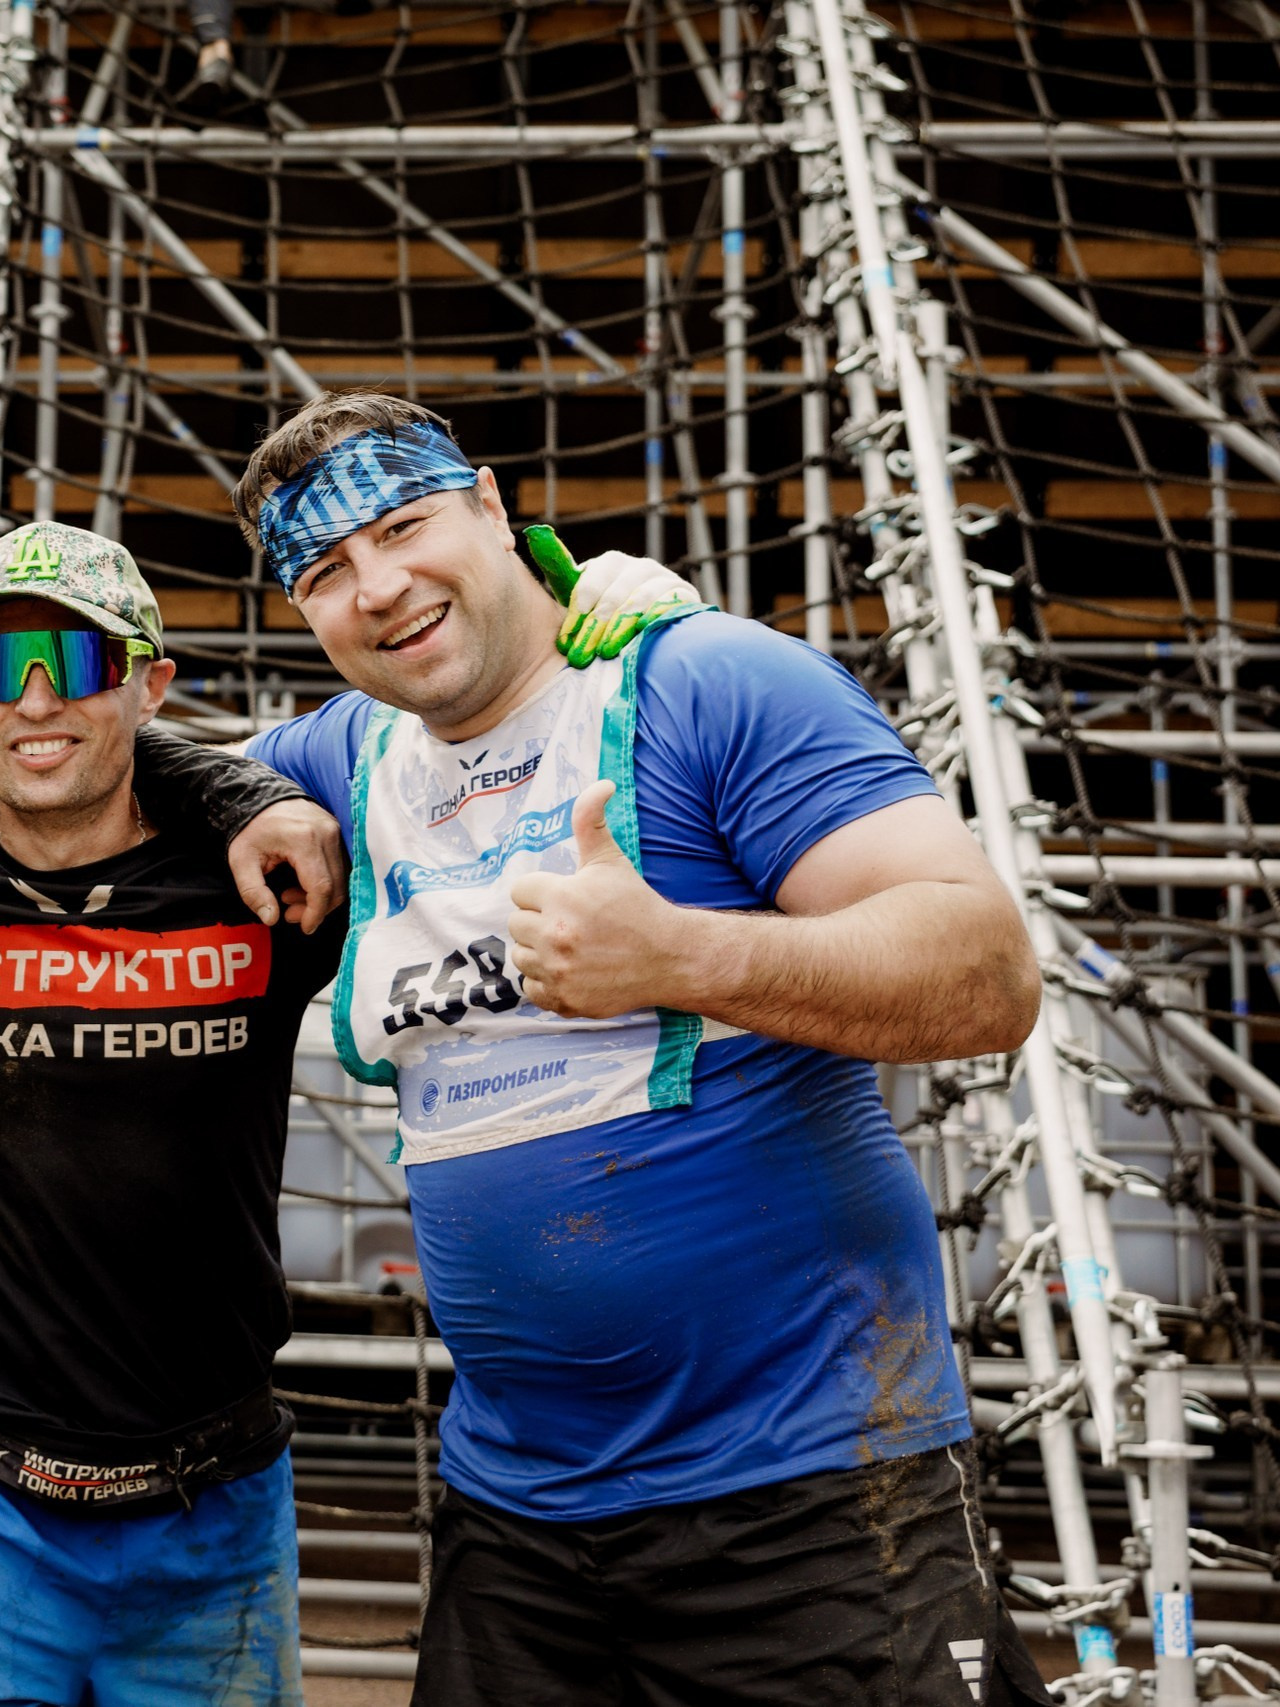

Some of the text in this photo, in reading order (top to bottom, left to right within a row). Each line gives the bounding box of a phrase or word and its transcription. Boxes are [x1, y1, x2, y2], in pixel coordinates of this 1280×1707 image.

[7, 527, 63, 581] LA
[382, 935, 524, 1036] 558
[72, 1015, 249, 1058] ГЕРОЕВ
[447, 1058, 568, 1103] ГАЗПРОМБАНК
[17, 1469, 149, 1500] ГОНКА ГЕРОЕВ
